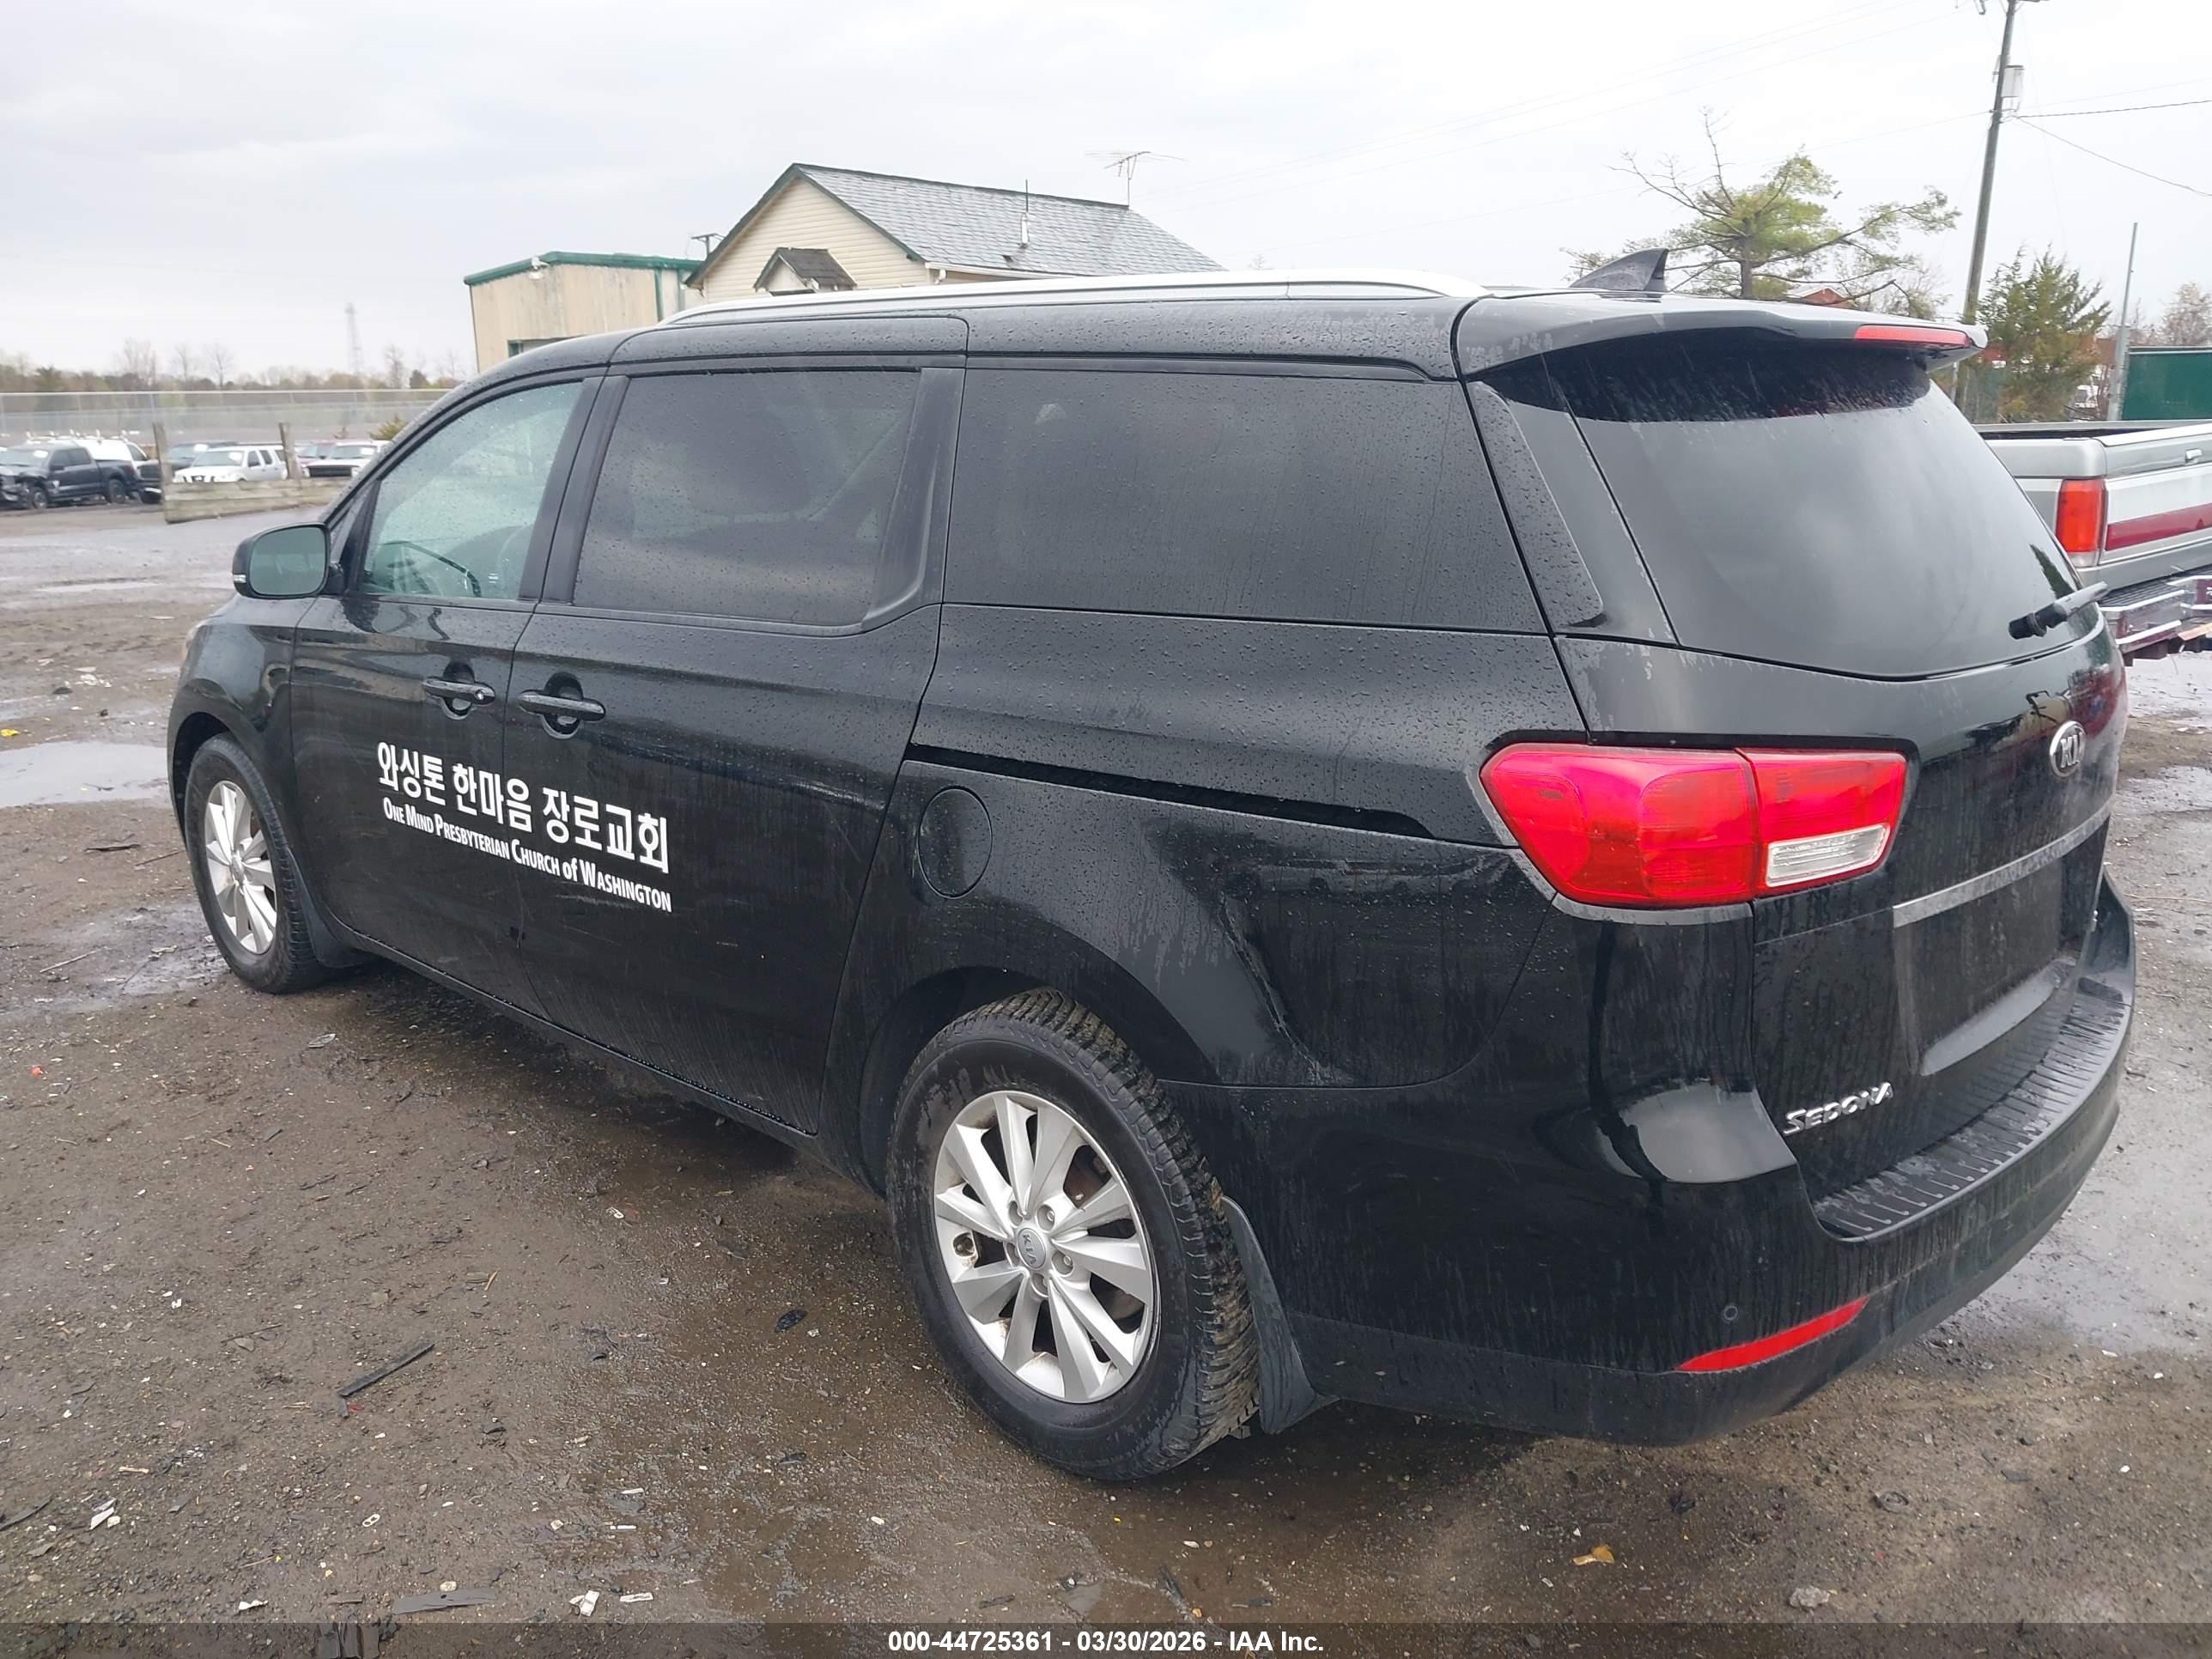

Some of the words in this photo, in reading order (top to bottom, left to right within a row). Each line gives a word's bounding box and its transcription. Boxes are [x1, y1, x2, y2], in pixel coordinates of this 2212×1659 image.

[377, 741, 446, 805] 와싱톤
[453, 762, 532, 833] 한마음
[542, 786, 669, 874] 장로교회
[562, 857, 579, 883] of
[1782, 1081, 1894, 1136] SEDONA
[1022, 1232, 1037, 1265] KIA
